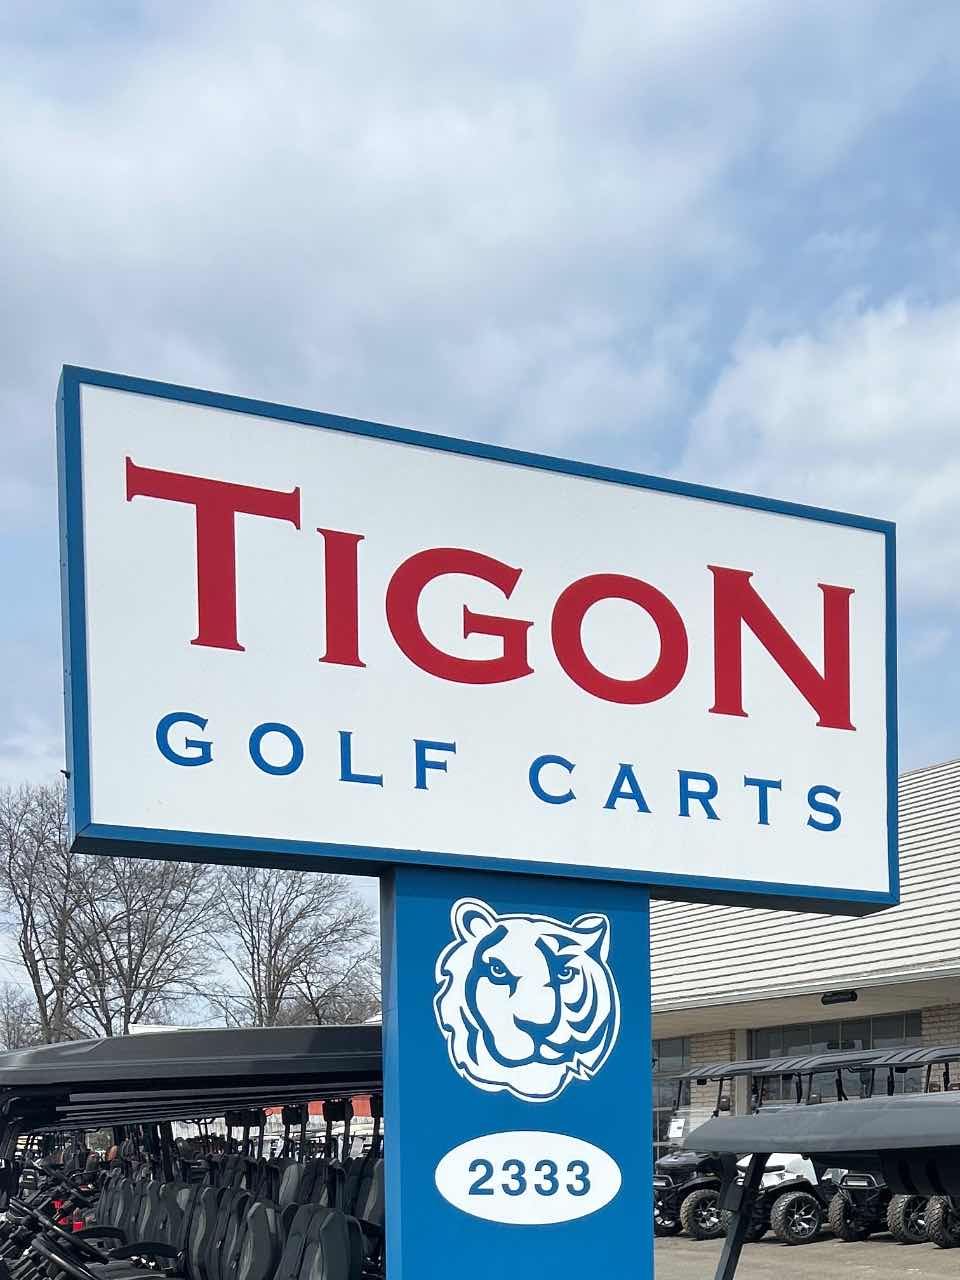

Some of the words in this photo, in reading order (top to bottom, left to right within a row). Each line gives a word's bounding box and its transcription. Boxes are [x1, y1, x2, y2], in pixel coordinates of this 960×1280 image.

[126, 456, 857, 732] TIGON
[155, 711, 457, 790] GOLF
[528, 754, 842, 833] CARTS
[468, 1158, 592, 1197] 2333
